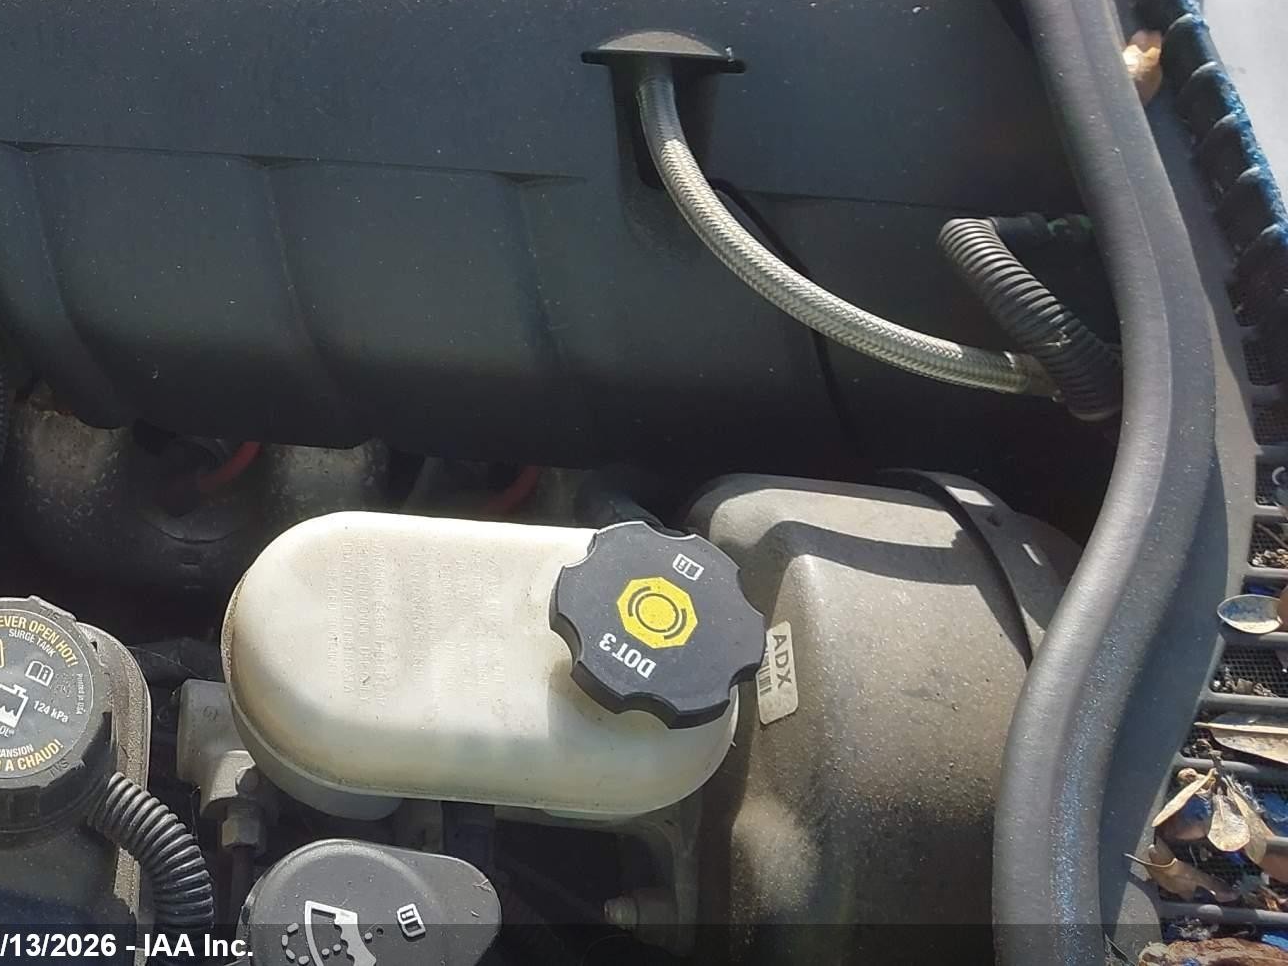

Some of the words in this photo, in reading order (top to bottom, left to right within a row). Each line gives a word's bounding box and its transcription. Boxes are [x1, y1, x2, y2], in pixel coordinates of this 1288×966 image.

[8, 628, 36, 643] SURGE
[36, 637, 58, 658] TANK
[28, 620, 60, 644] OPEN
[55, 639, 79, 668] HOT!
[599, 632, 617, 652] 3
[612, 642, 657, 679] DOT
[772, 633, 793, 690] ADX
[33, 700, 51, 715] 124
[50, 707, 69, 723] kPa
[17, 738, 64, 770] CHAUD!
